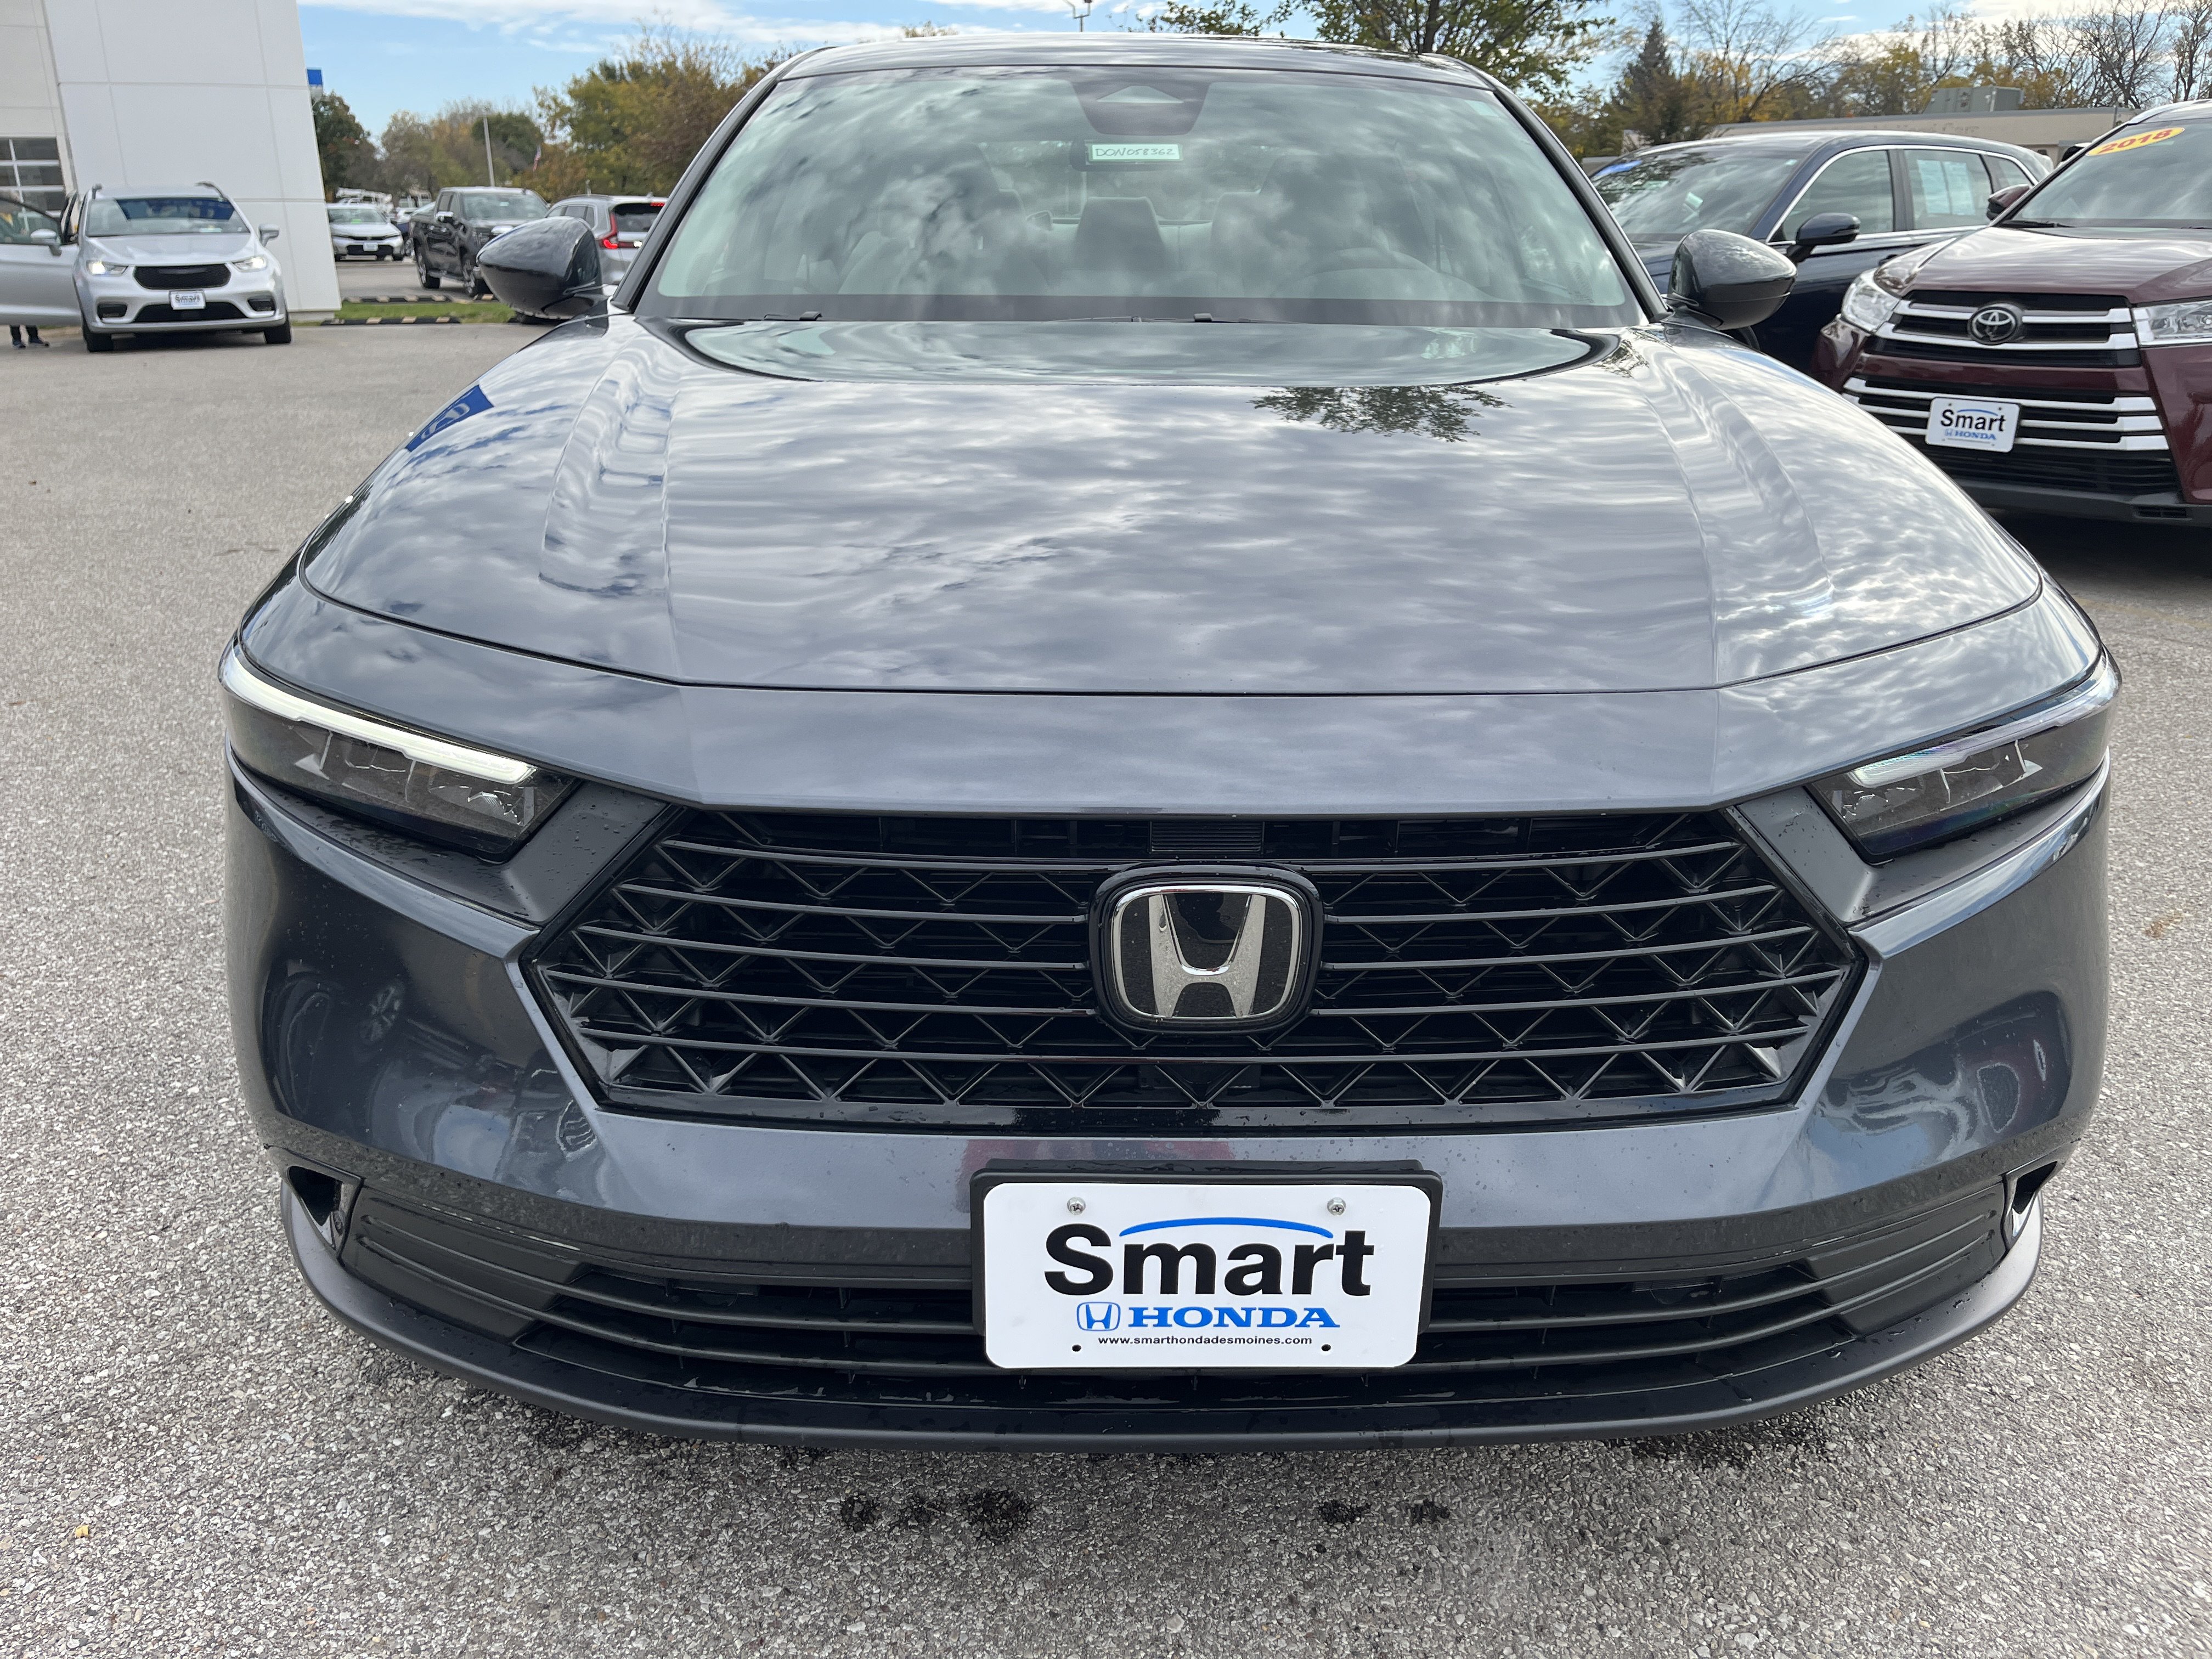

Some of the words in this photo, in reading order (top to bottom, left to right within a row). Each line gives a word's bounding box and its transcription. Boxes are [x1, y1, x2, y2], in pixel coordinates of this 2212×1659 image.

[2097, 129, 2173, 154] 2018
[1940, 409, 2006, 432] Smart
[1955, 430, 1996, 440] HONDA
[1044, 1223, 1375, 1297] Smart
[1128, 1307, 1340, 1329] HONDA
[1098, 1335, 1312, 1345] www.smarthondadesmoines.com
